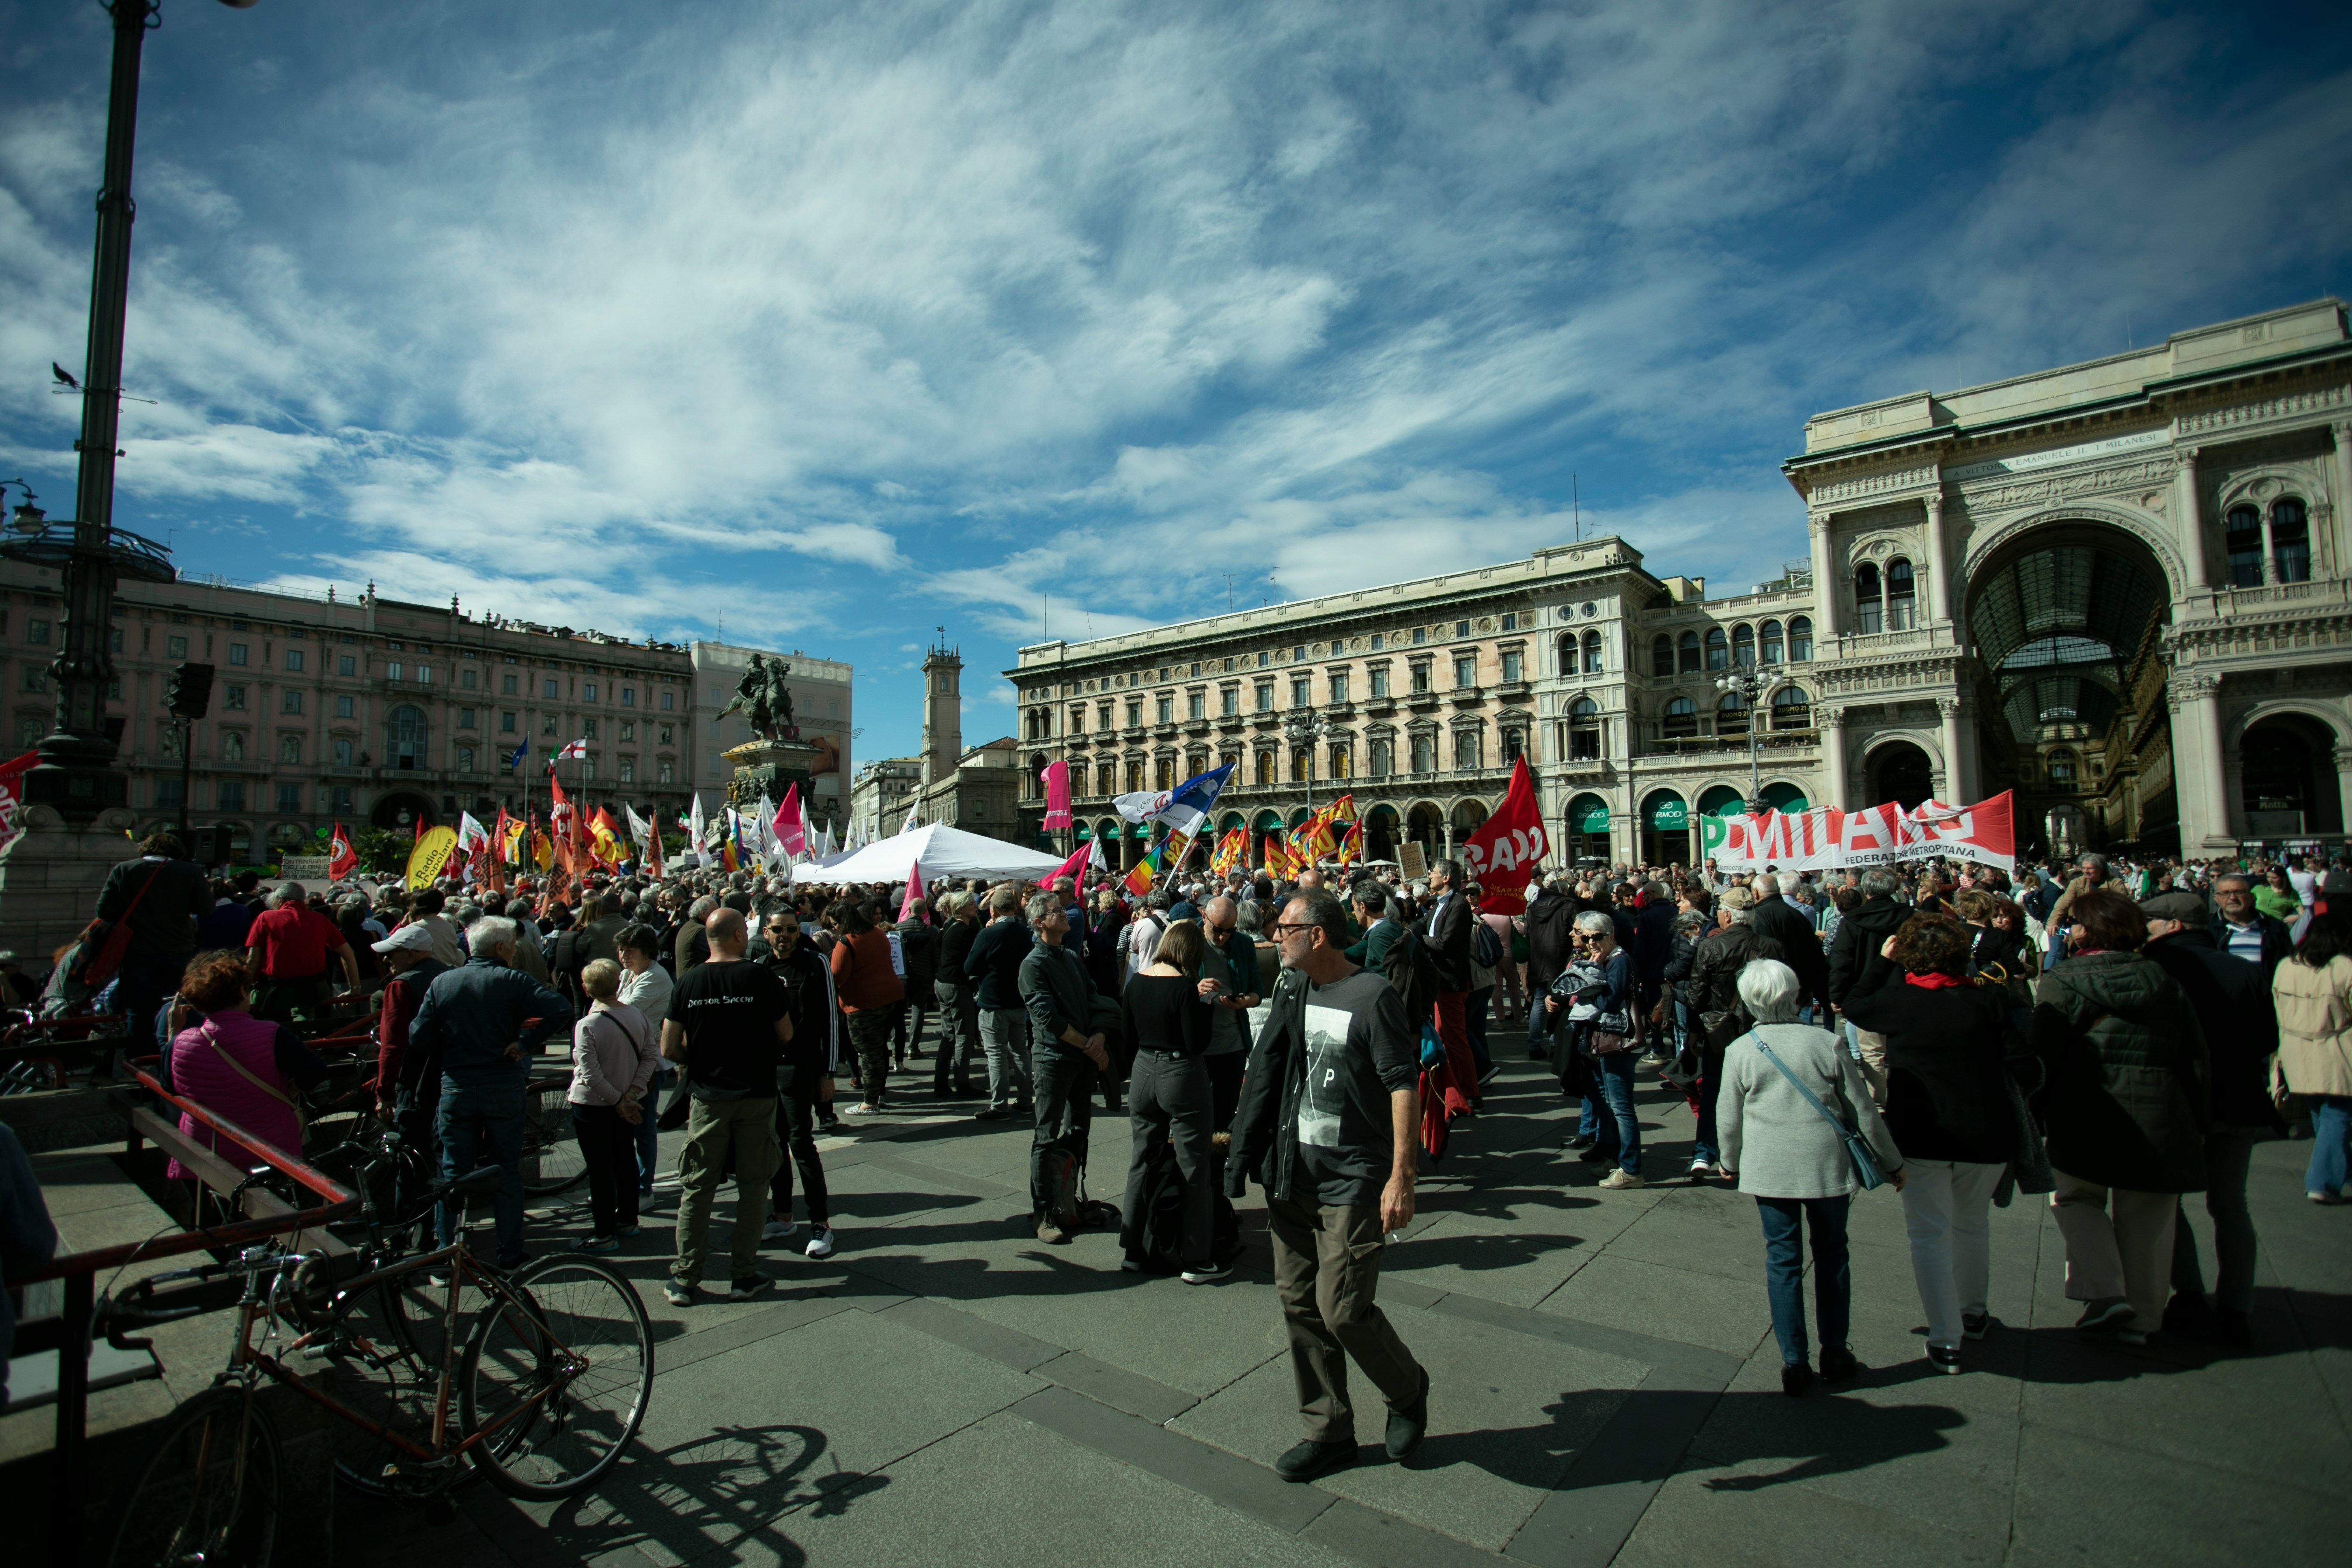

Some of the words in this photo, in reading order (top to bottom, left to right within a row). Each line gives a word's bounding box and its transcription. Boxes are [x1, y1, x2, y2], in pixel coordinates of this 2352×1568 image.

[1965, 462, 2010, 474] VITTORIO
[2016, 449, 2072, 465] EMANUELE
[2106, 434, 2156, 449] MILANESI
[415, 849, 439, 880] Radio
[423, 838, 453, 882] Popolare
[1323, 1068, 1335, 1087] P
